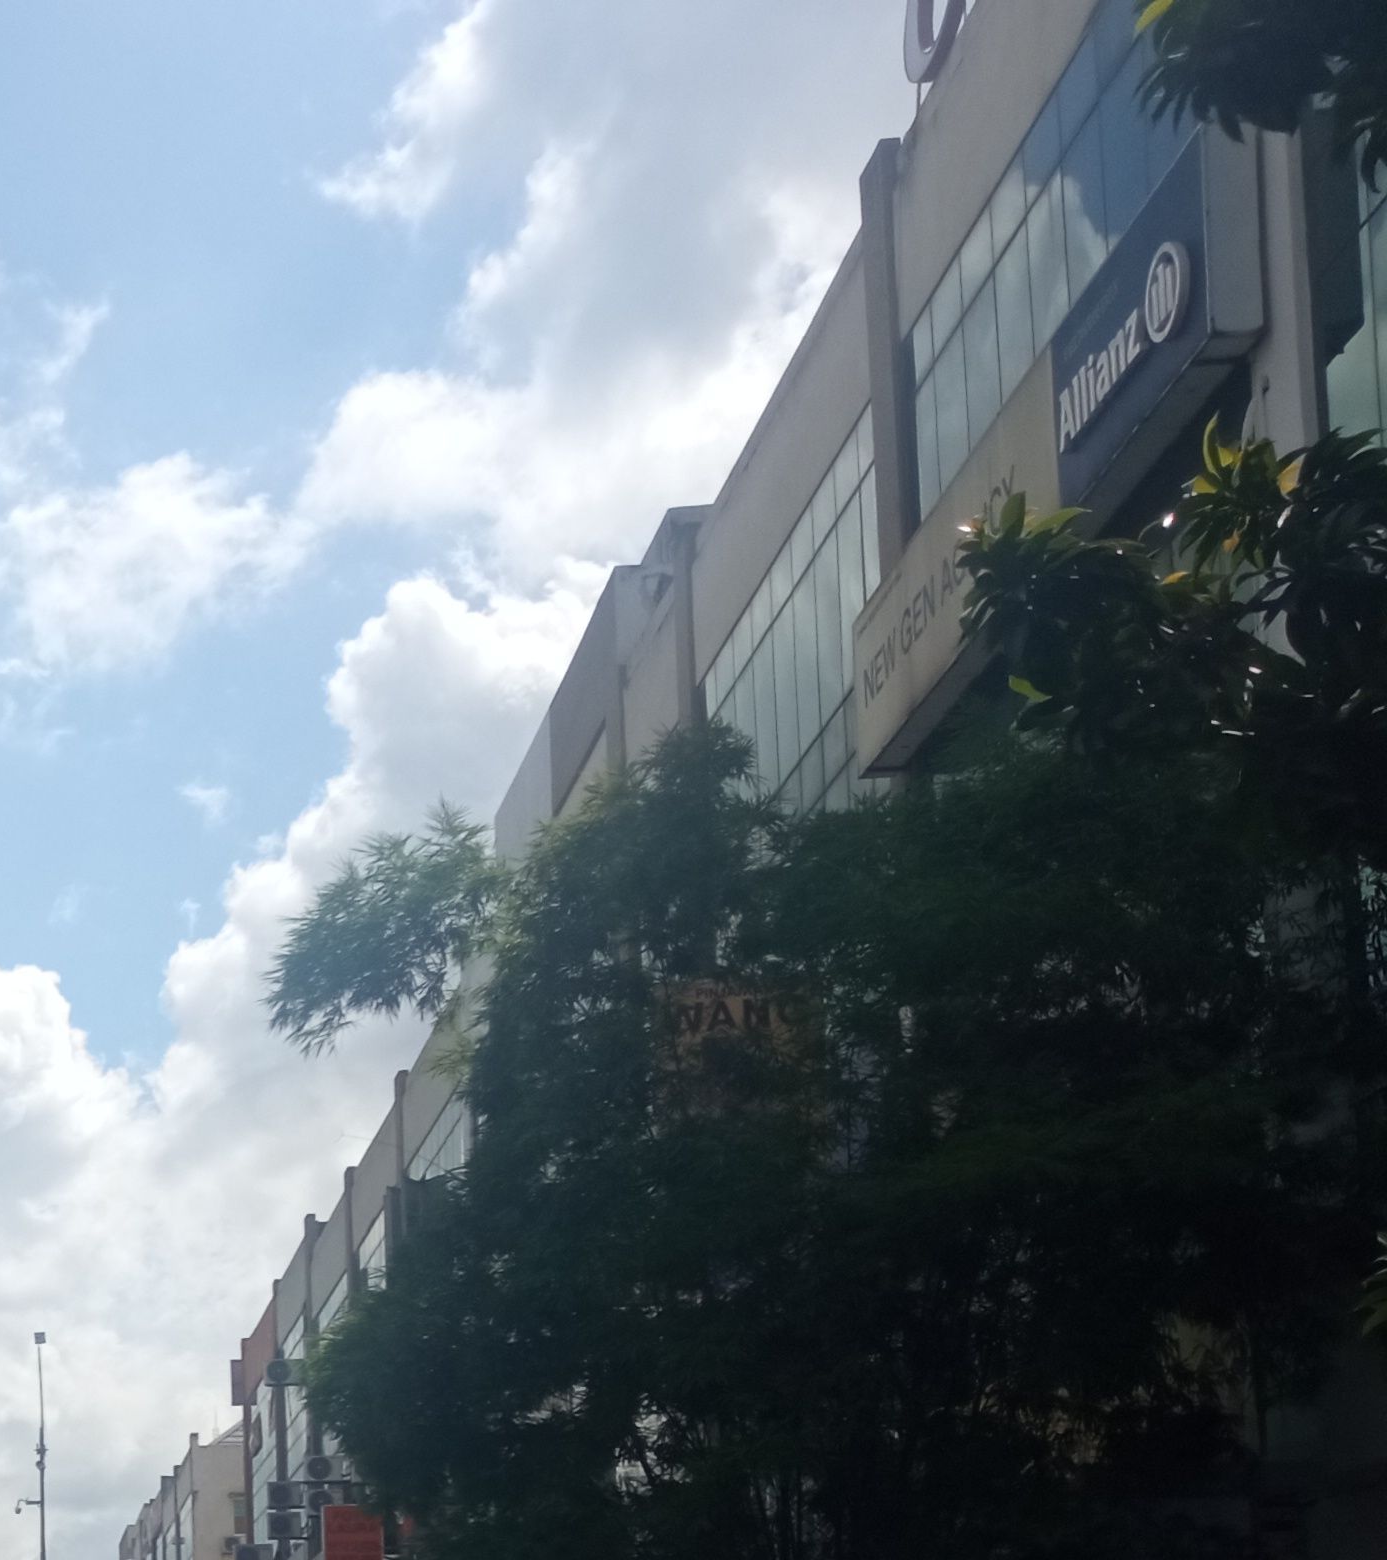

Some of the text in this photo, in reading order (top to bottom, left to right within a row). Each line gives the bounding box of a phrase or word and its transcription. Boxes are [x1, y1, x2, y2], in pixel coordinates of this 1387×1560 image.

[1059, 307, 1141, 453] Allianz
[862, 627, 896, 708] NEW
[901, 575, 936, 655] GEN
